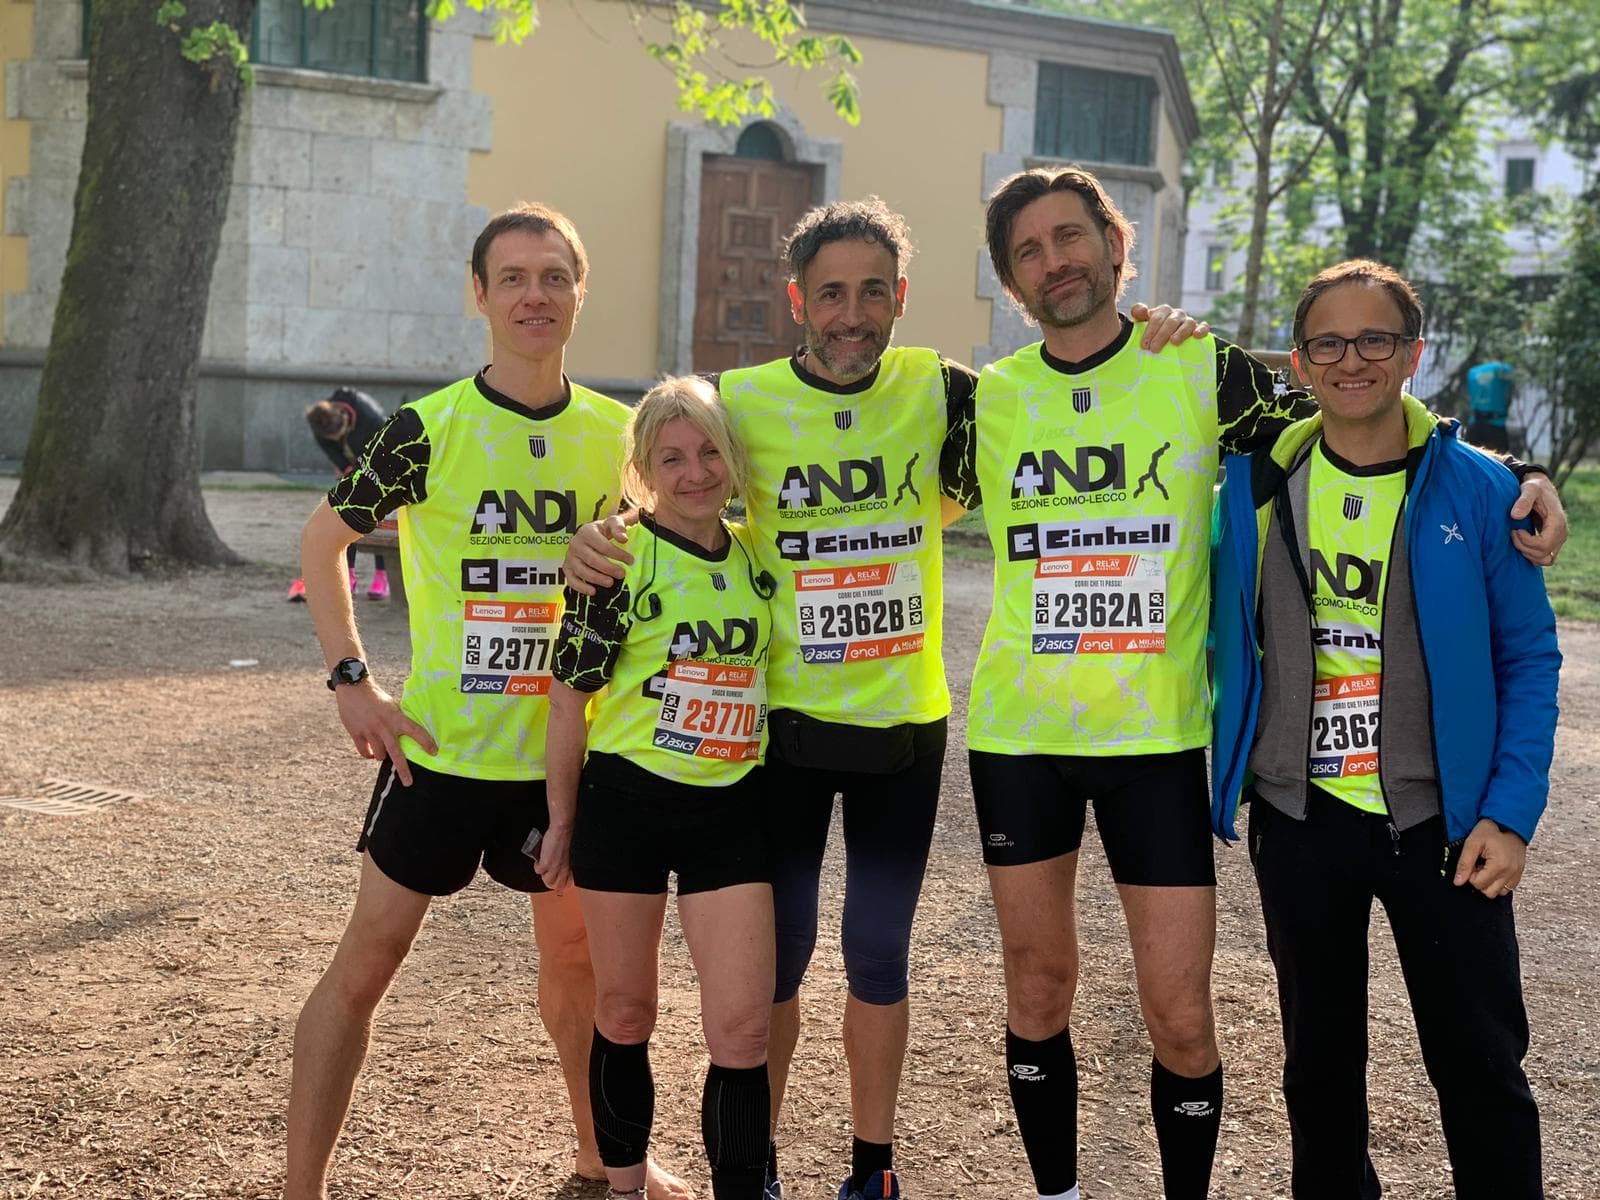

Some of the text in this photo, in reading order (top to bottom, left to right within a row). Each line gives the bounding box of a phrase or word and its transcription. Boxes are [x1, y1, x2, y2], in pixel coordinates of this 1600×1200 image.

[1011, 443, 1127, 500] ANDI
[777, 456, 887, 509] ANDI
[779, 500, 888, 519] SEZIONE COMO-LECCO
[1011, 492, 1127, 511] SEZIONE COMO-LECCO
[470, 490, 577, 534] ANDI
[470, 536, 570, 545] SEZIONE COMO-LECC
[815, 525, 922, 553] Einhell
[1046, 523, 1171, 549] Einhell
[1043, 559, 1119, 572] Lenovo RELAY
[804, 570, 879, 585] Lenovo RELAY
[1309, 548, 1384, 606] NDI
[475, 606, 549, 616] Lenovo RELAY
[820, 599, 905, 638] 2362B
[1054, 592, 1143, 628] 2362A
[667, 617, 758, 662] ANDI
[1046, 639, 1074, 650] asics
[1083, 638, 1114, 650] enel
[816, 649, 841, 660] asics
[850, 645, 879, 658] enel
[678, 666, 706, 678] Lenovo
[476, 680, 539, 692] asics enel
[1351, 680, 1375, 688] RELAY
[667, 737, 731, 758] asics enel
[1312, 757, 1379, 773] asics enel
[1187, 1107, 1214, 1116] SPORT
